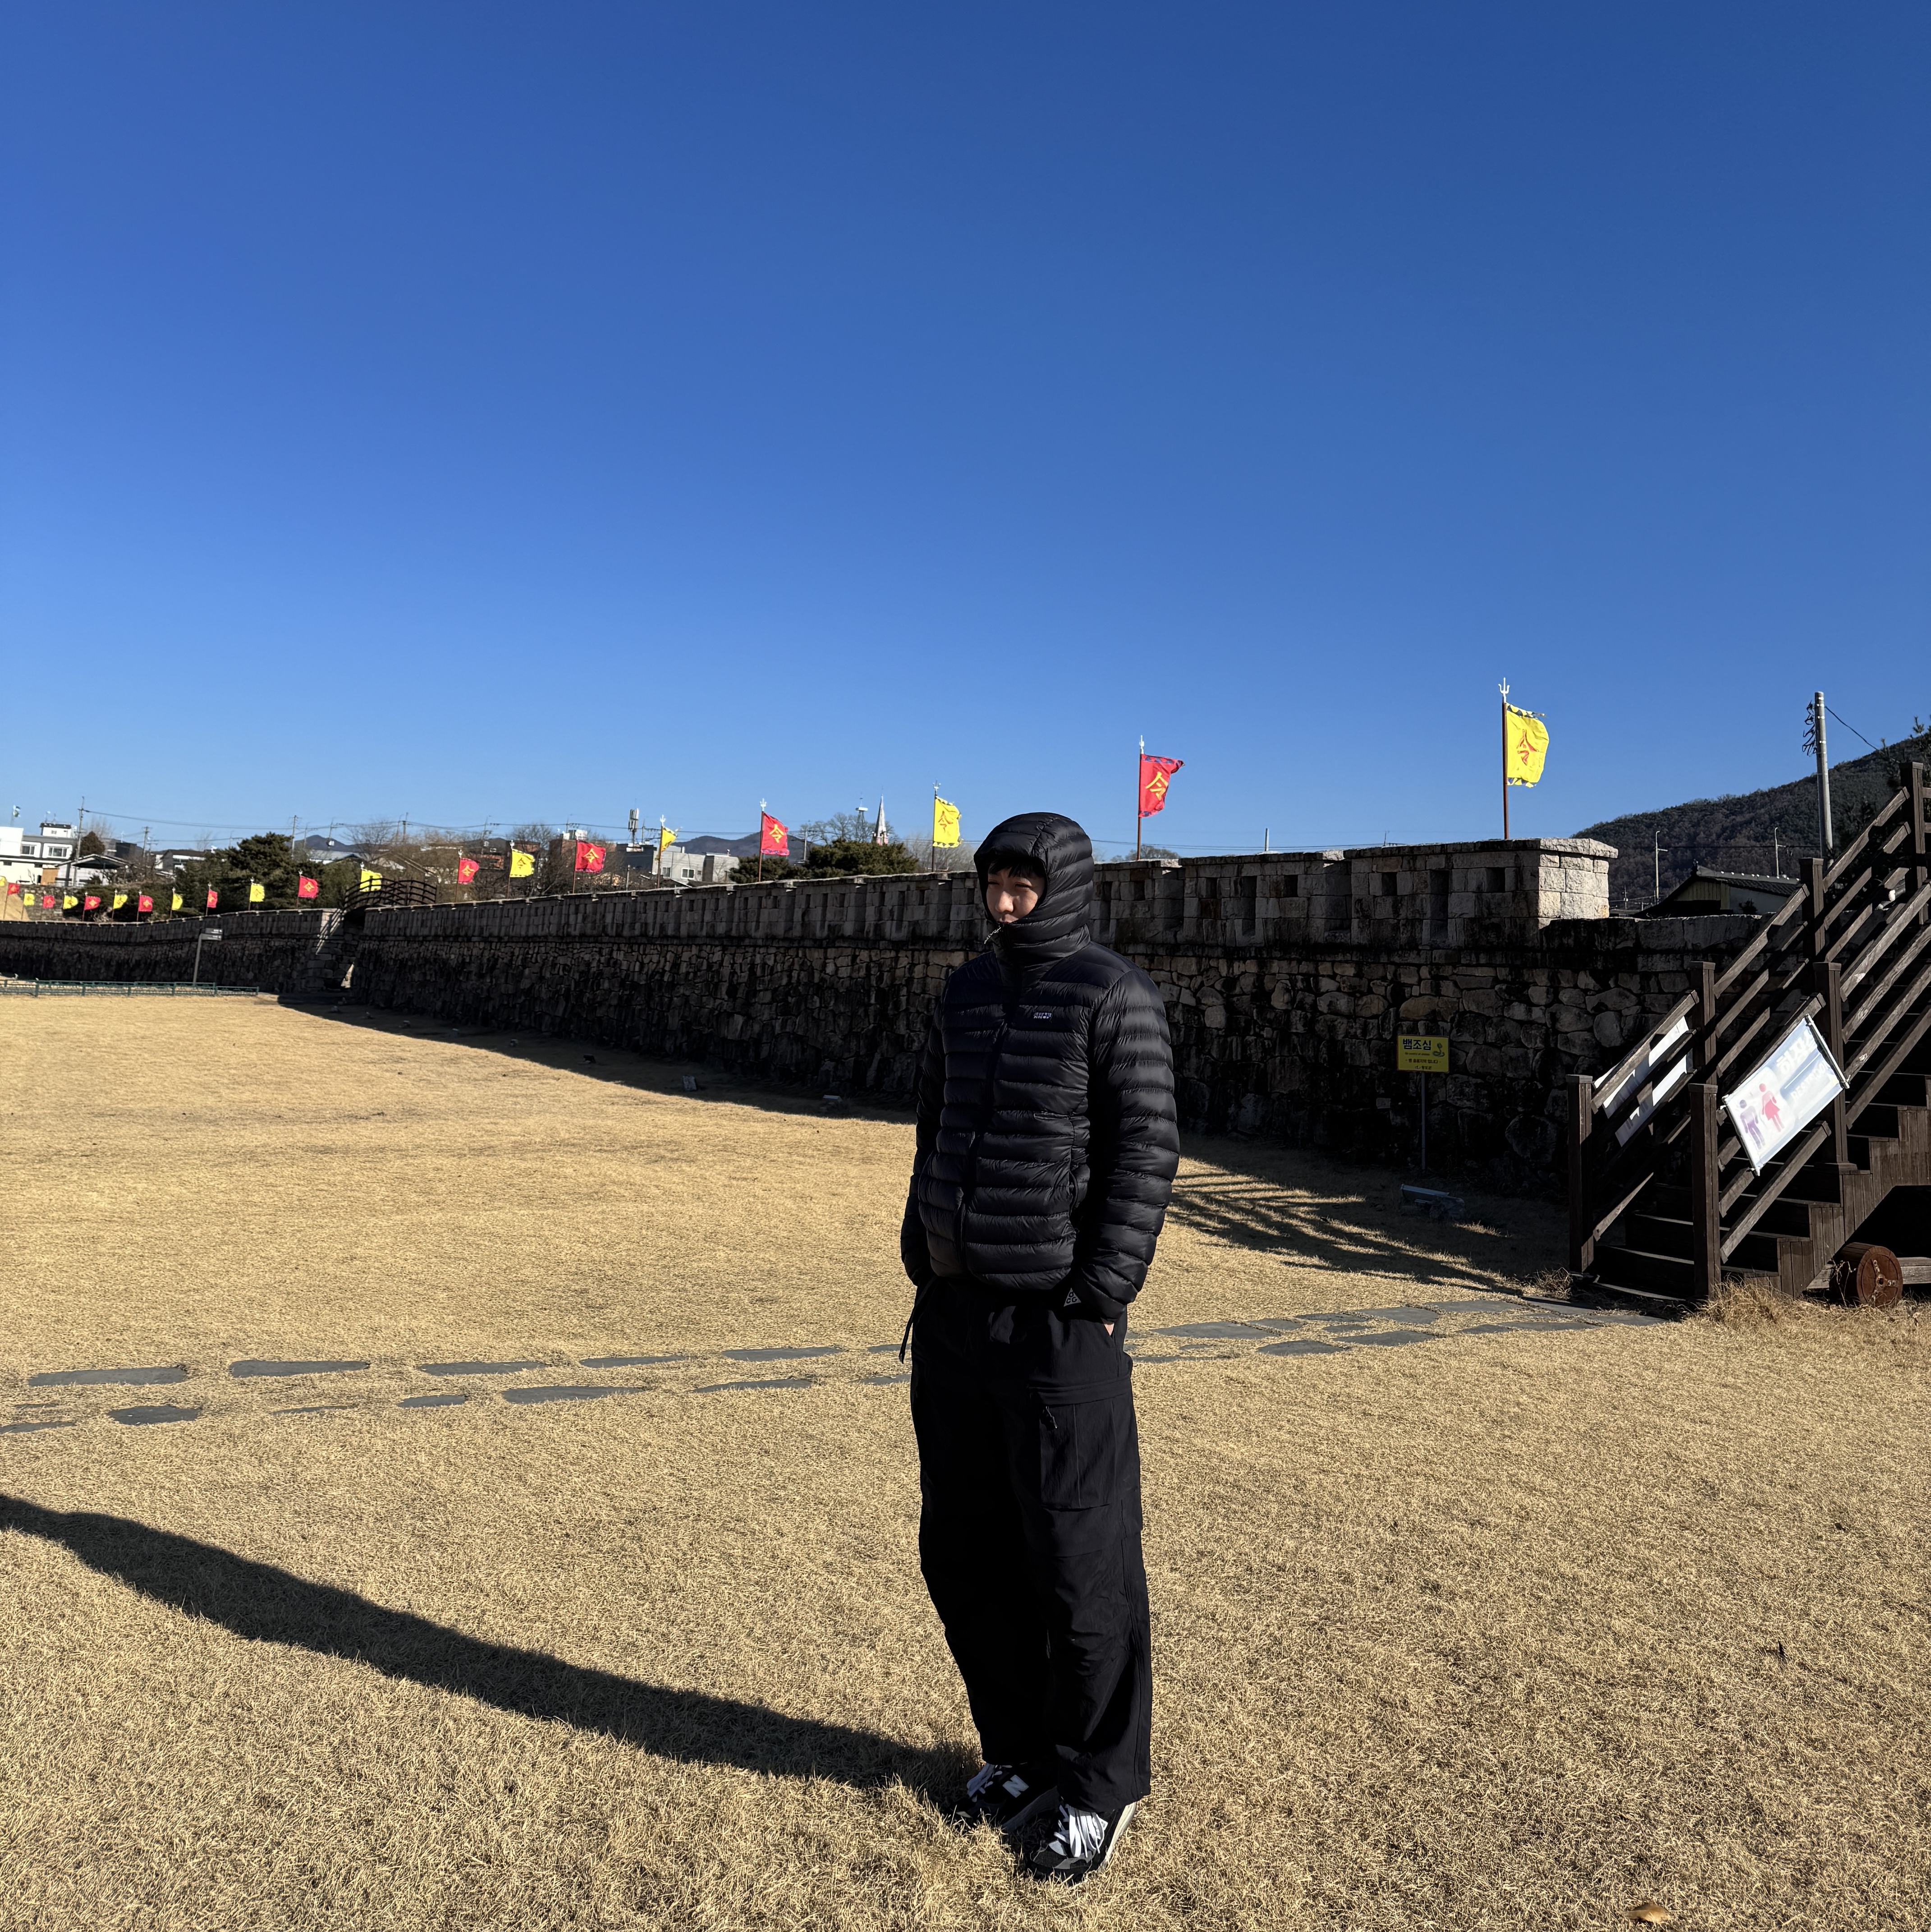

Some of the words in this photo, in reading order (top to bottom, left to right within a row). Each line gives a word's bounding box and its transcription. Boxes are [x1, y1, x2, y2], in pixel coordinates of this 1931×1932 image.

[1145, 771, 1169, 801] 令
[769, 823, 784, 843] 令
[1403, 1038, 1431, 1051] 뱀조심
